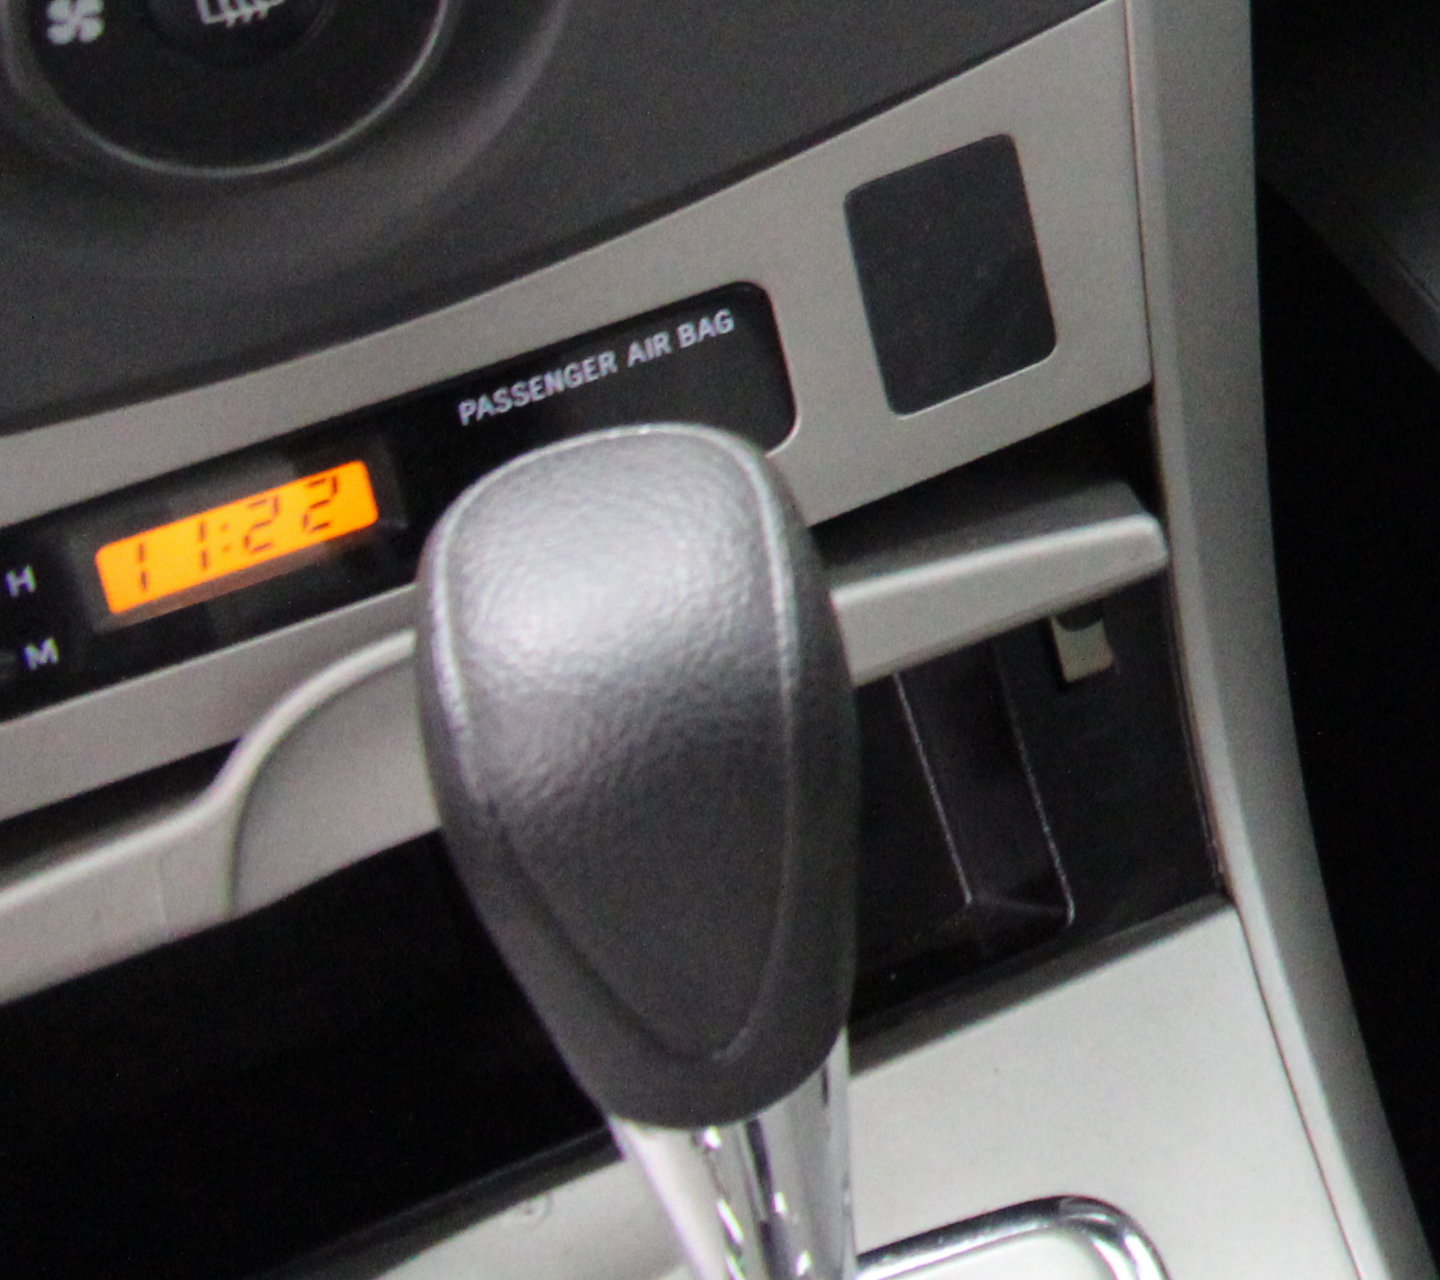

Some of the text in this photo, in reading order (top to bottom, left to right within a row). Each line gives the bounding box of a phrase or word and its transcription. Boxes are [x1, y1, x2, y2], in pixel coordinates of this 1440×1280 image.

[457, 308, 735, 426] PASSENGER AIR BAG
[136, 474, 340, 593] 11:22
[5, 565, 37, 597] H
[23, 636, 60, 672] M
